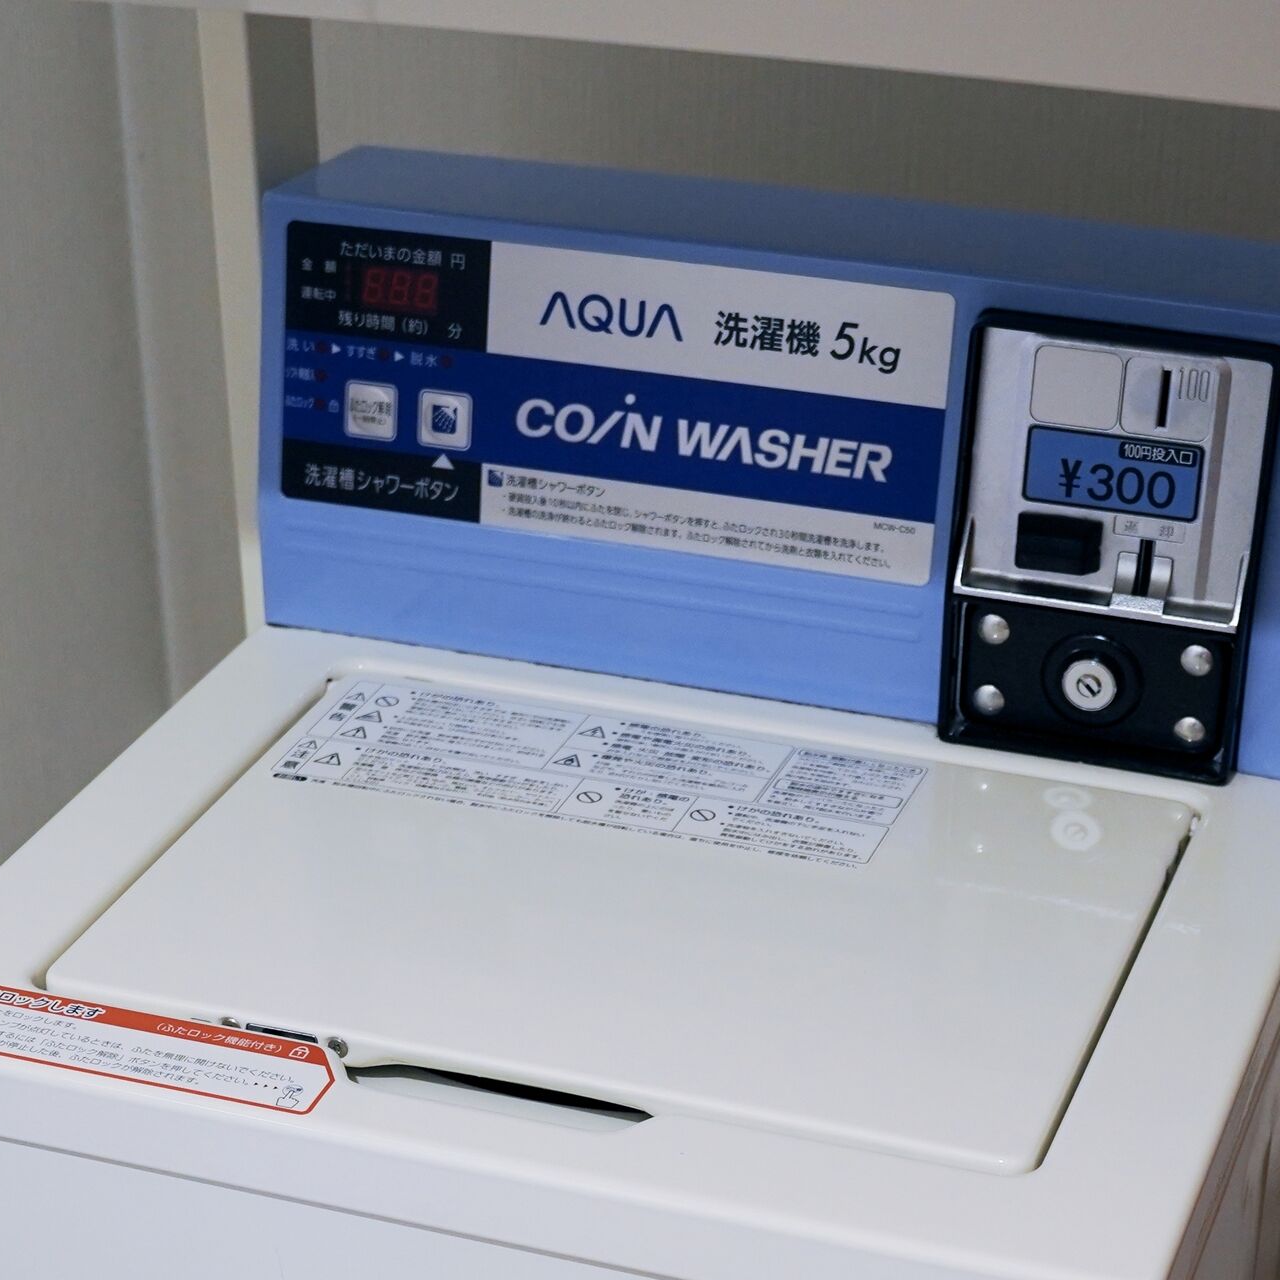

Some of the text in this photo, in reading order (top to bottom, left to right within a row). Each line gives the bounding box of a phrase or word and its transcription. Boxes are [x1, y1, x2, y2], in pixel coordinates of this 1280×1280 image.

[340, 241, 466, 271] ただいまの金額 円
[448, 322, 463, 340] 分
[539, 291, 683, 342] AQUA
[713, 310, 901, 375] 洗濯機 5kg
[1178, 366, 1210, 403] 100
[677, 418, 893, 483] WASHER
[1123, 443, 1193, 465] 100円投入口
[305, 463, 460, 502] 洗濯槽シャワーボタン
[1058, 457, 1176, 510] ¥300
